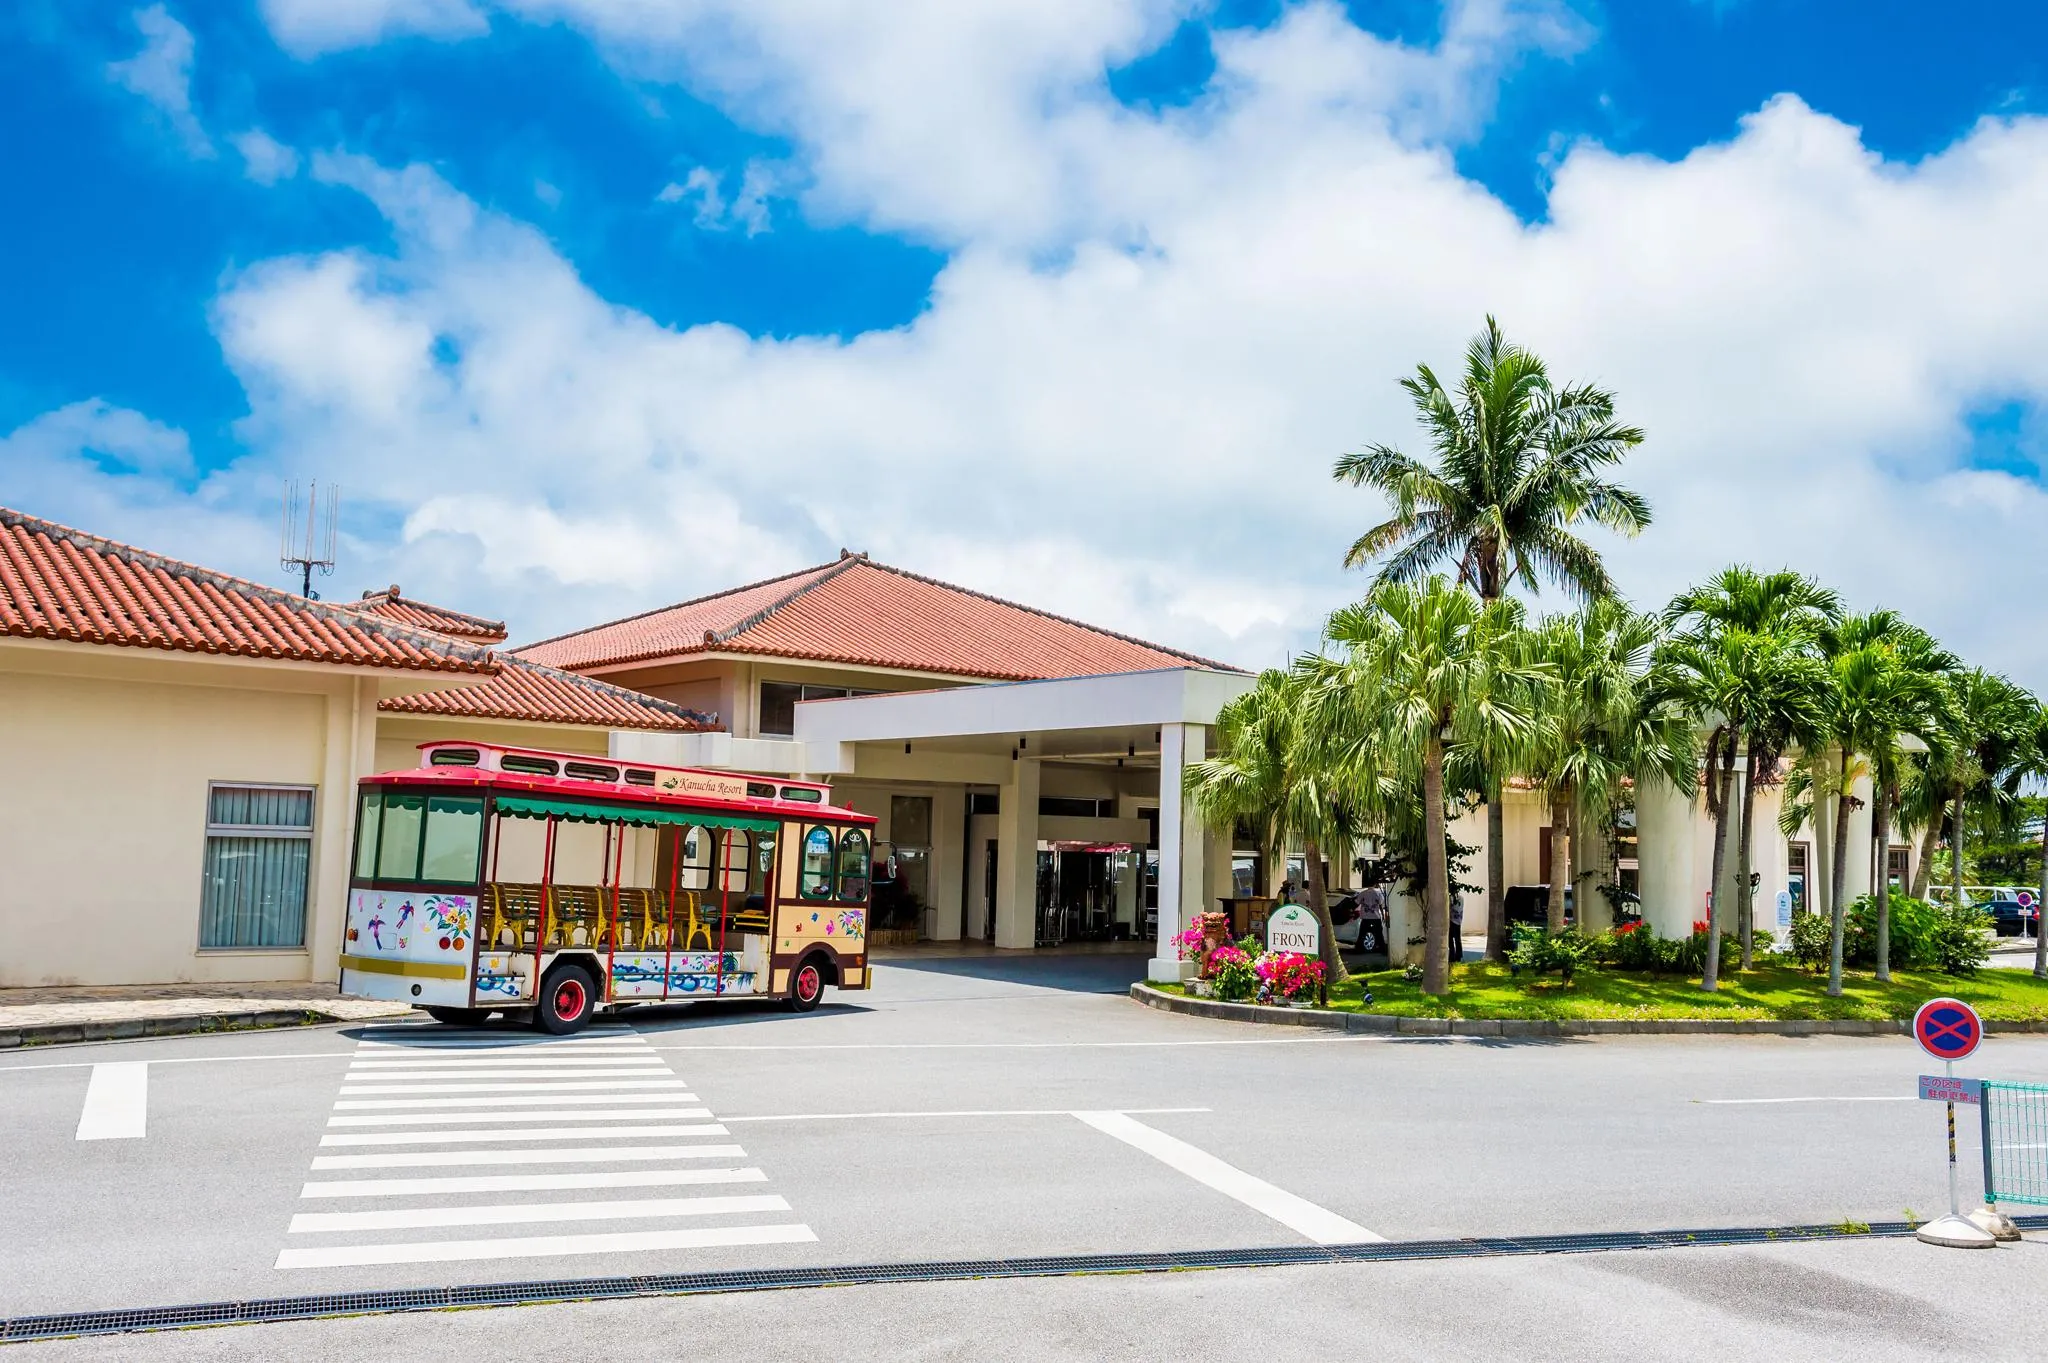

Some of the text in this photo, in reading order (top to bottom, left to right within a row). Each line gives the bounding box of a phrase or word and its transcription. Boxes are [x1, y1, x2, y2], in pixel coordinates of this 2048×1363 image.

[679, 777, 742, 795] Kanucha Resort
[1272, 932, 1315, 948] FRONT
